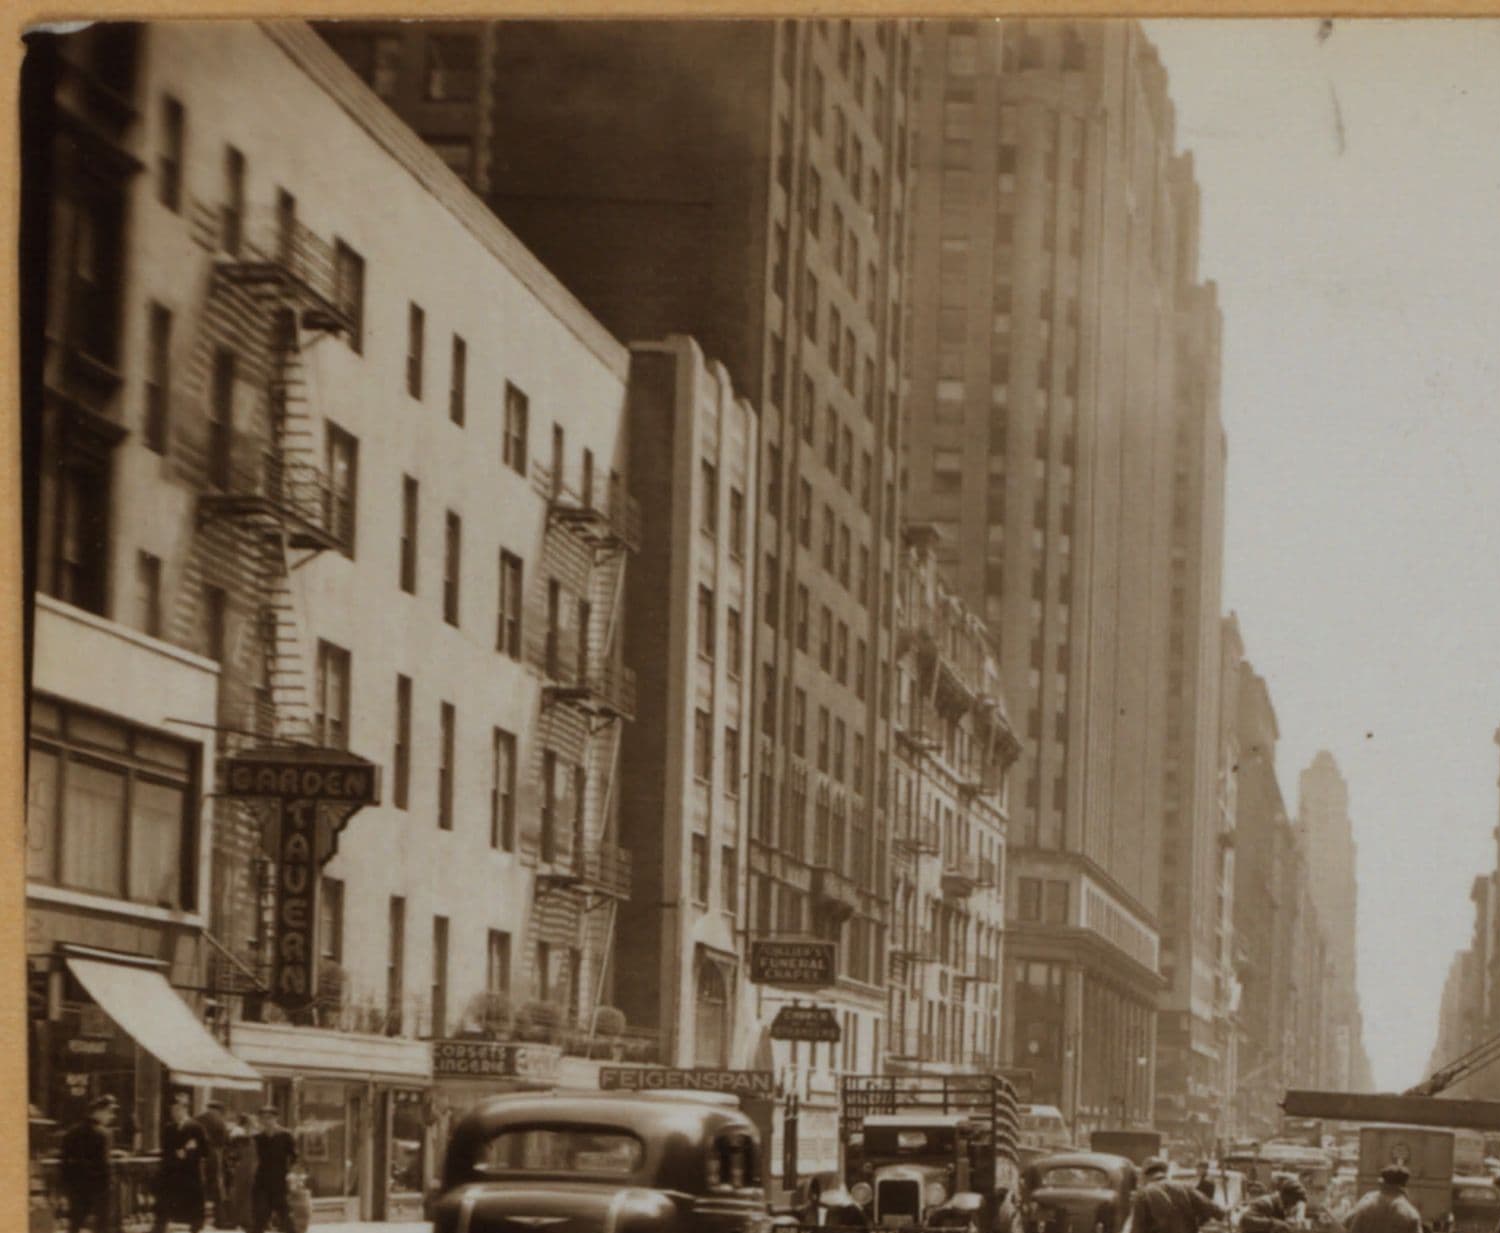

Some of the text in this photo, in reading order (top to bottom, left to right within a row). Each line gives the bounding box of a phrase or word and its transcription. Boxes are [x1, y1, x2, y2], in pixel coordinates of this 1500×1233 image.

[232, 766, 367, 797] GARDEN
[759, 957, 827, 969] FUNERAL
[602, 1070, 770, 1090] FEIGENSPAN
